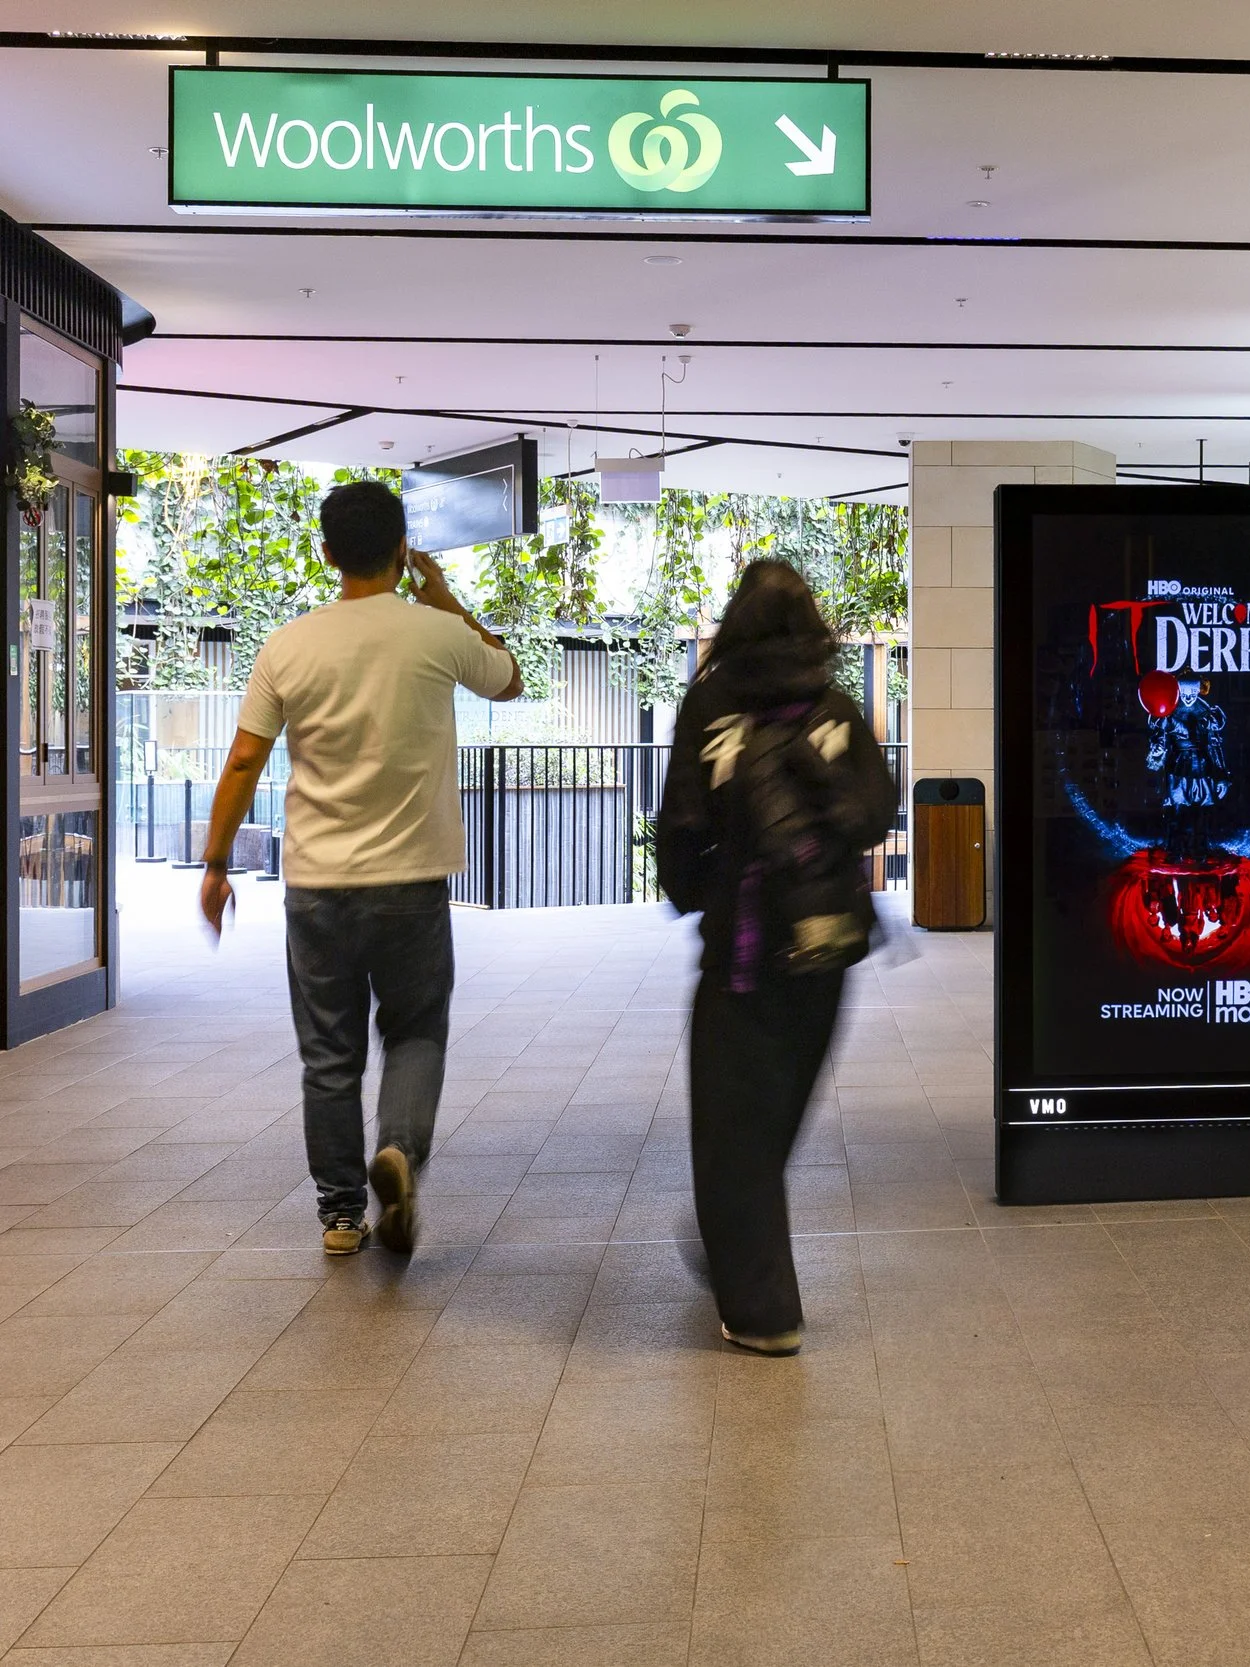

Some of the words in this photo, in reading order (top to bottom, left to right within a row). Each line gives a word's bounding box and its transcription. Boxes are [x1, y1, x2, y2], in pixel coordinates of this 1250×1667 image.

[213, 103, 594, 174] Woolworths
[1147, 580, 1182, 595] HBO
[1182, 586, 1235, 596] ORIGINAL
[1089, 600, 1174, 679] IT
[1158, 988, 1204, 1002] NOW
[1100, 1004, 1204, 1019] STREAMING
[1029, 1098, 1067, 1114] VMO
